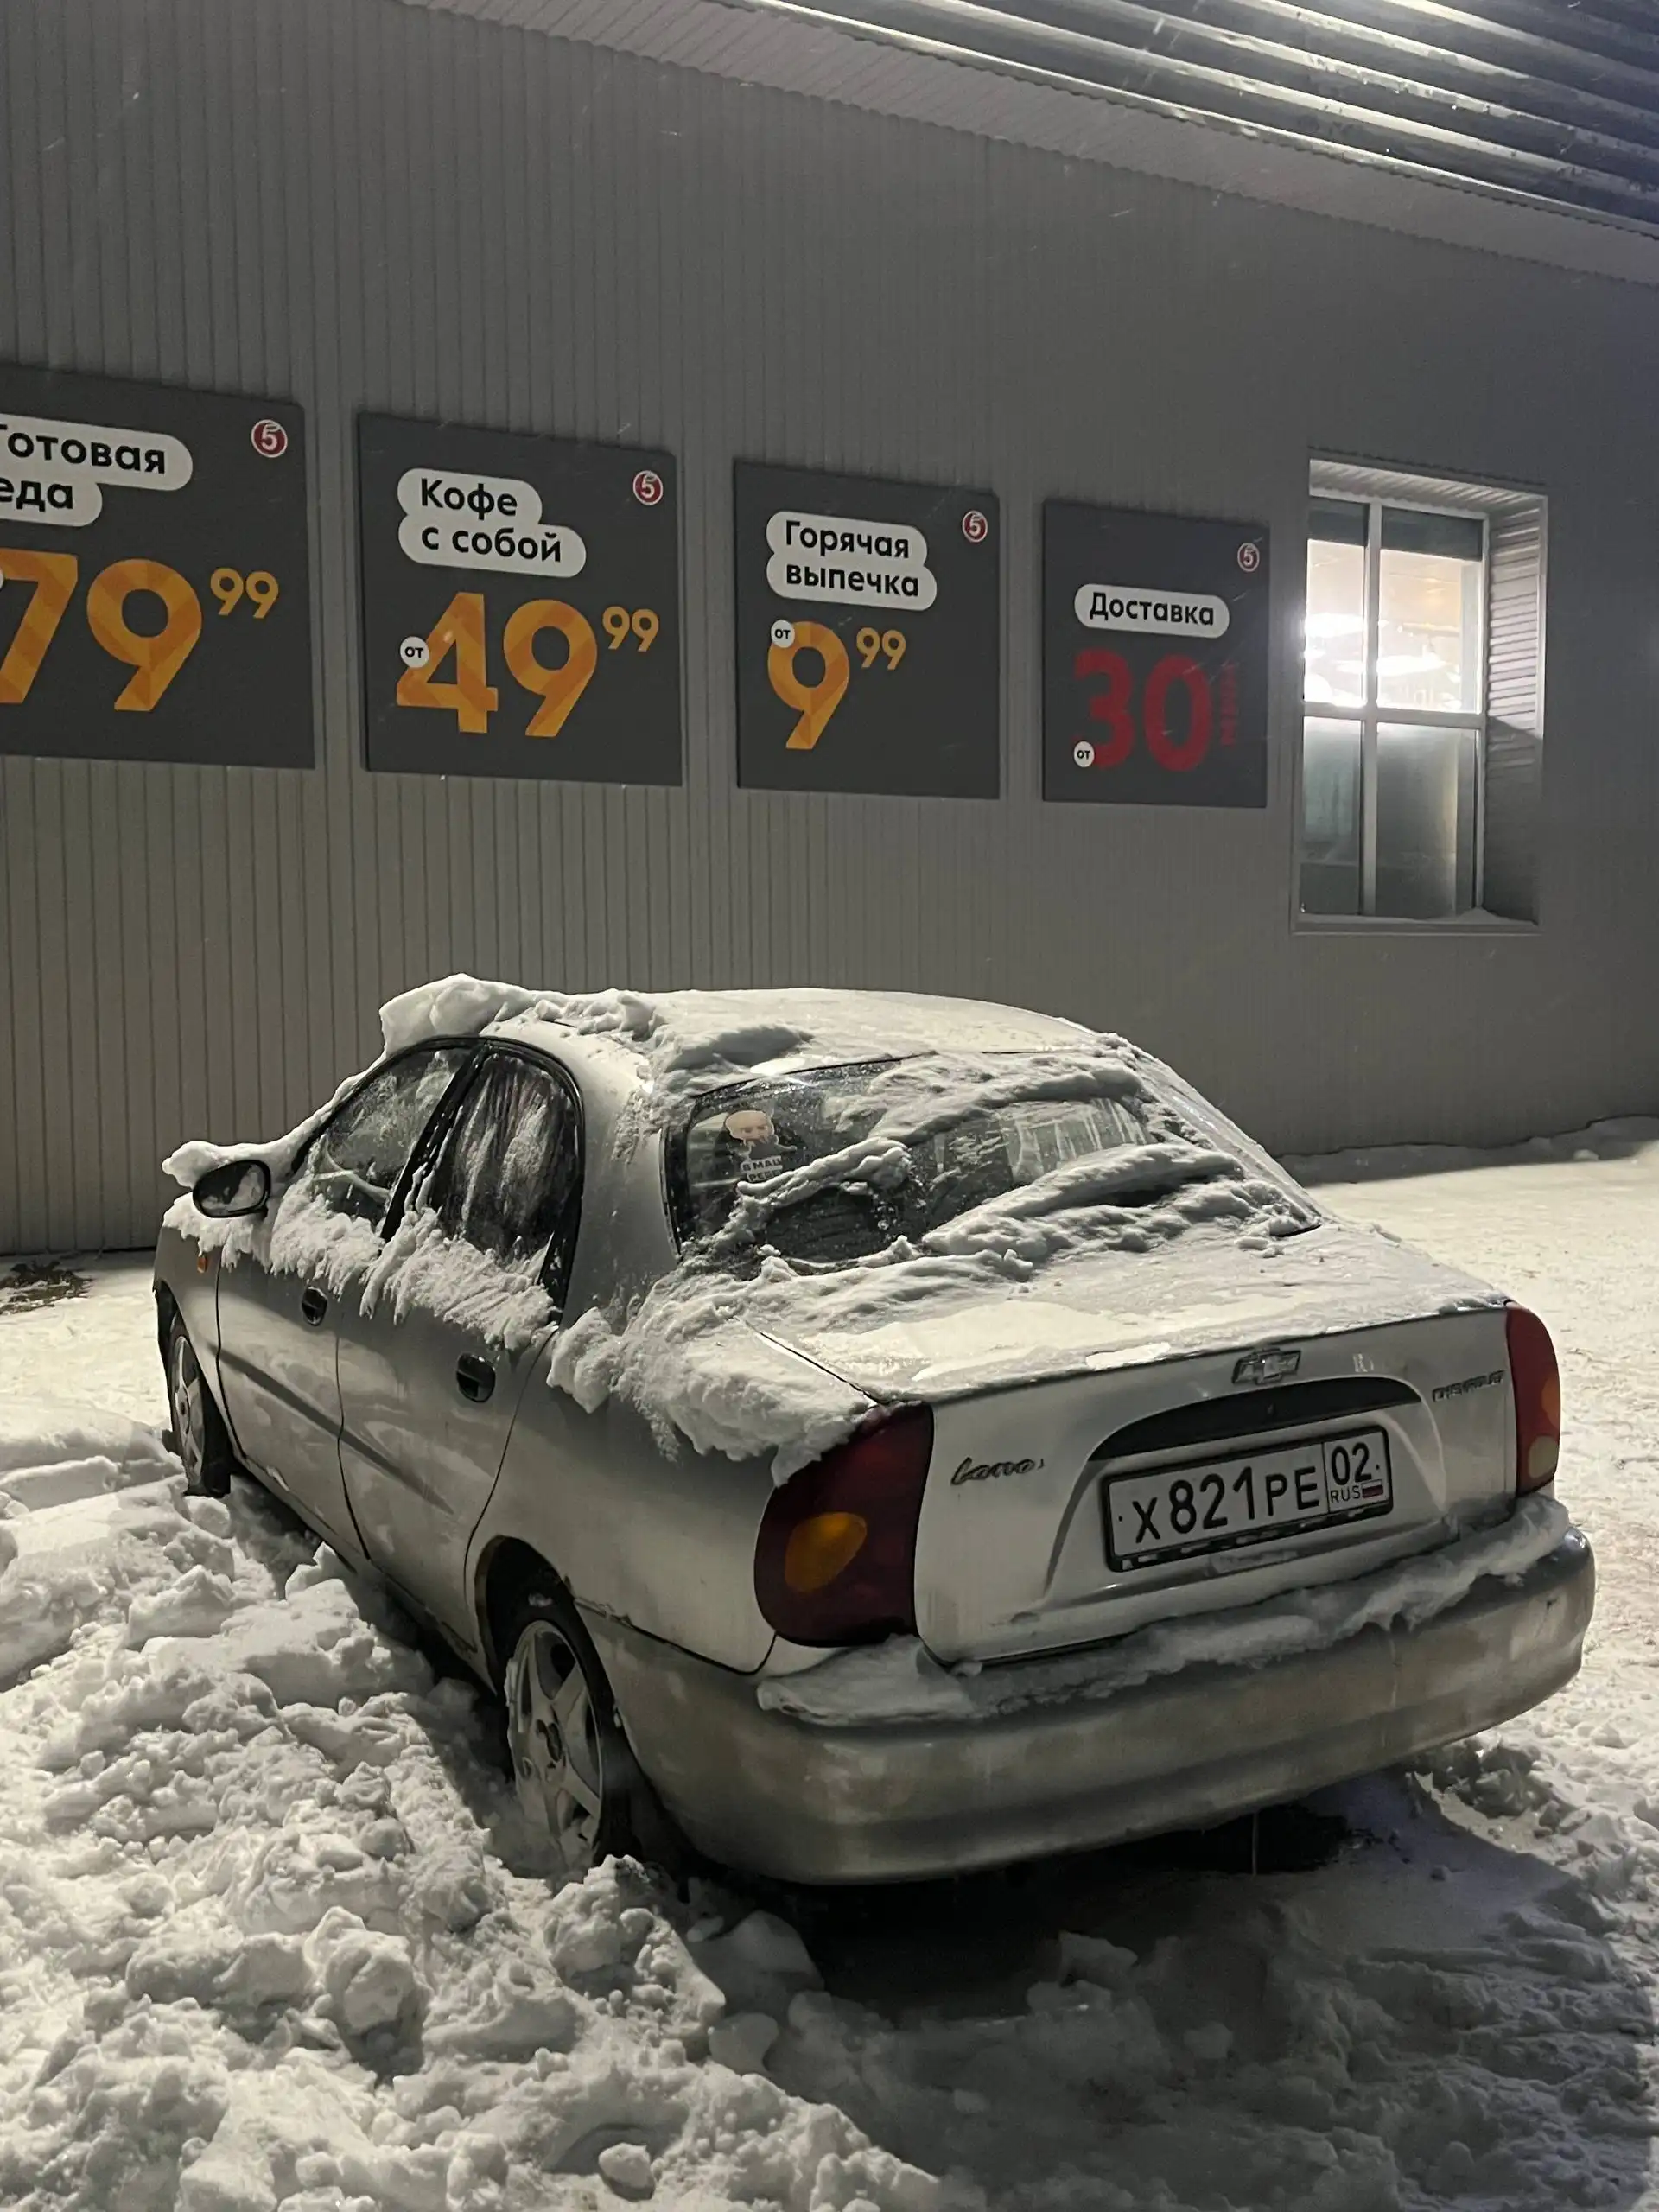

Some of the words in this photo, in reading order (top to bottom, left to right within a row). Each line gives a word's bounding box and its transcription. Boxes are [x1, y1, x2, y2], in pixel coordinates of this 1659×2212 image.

[0, 424, 165, 474] отовая
[421, 478, 518, 520] Кофе
[422, 526, 439, 550] с
[452, 528, 561, 563] собой
[785, 520, 909, 559] Горячая
[785, 564, 918, 597] выпечка
[0, 547, 203, 711] 79
[210, 567, 279, 619] 99
[602, 606, 659, 652] 99
[1089, 592, 1214, 626] Доставка
[404, 645, 423, 658] от
[774, 628, 791, 640] от
[856, 627, 906, 671] 99
[397, 591, 598, 737] 49
[767, 620, 850, 749] 9
[1071, 649, 1213, 772] 30
[1077, 749, 1090, 760] от
[1331, 1441, 1372, 1486] 02
[1330, 1487, 1362, 1504] RUS
